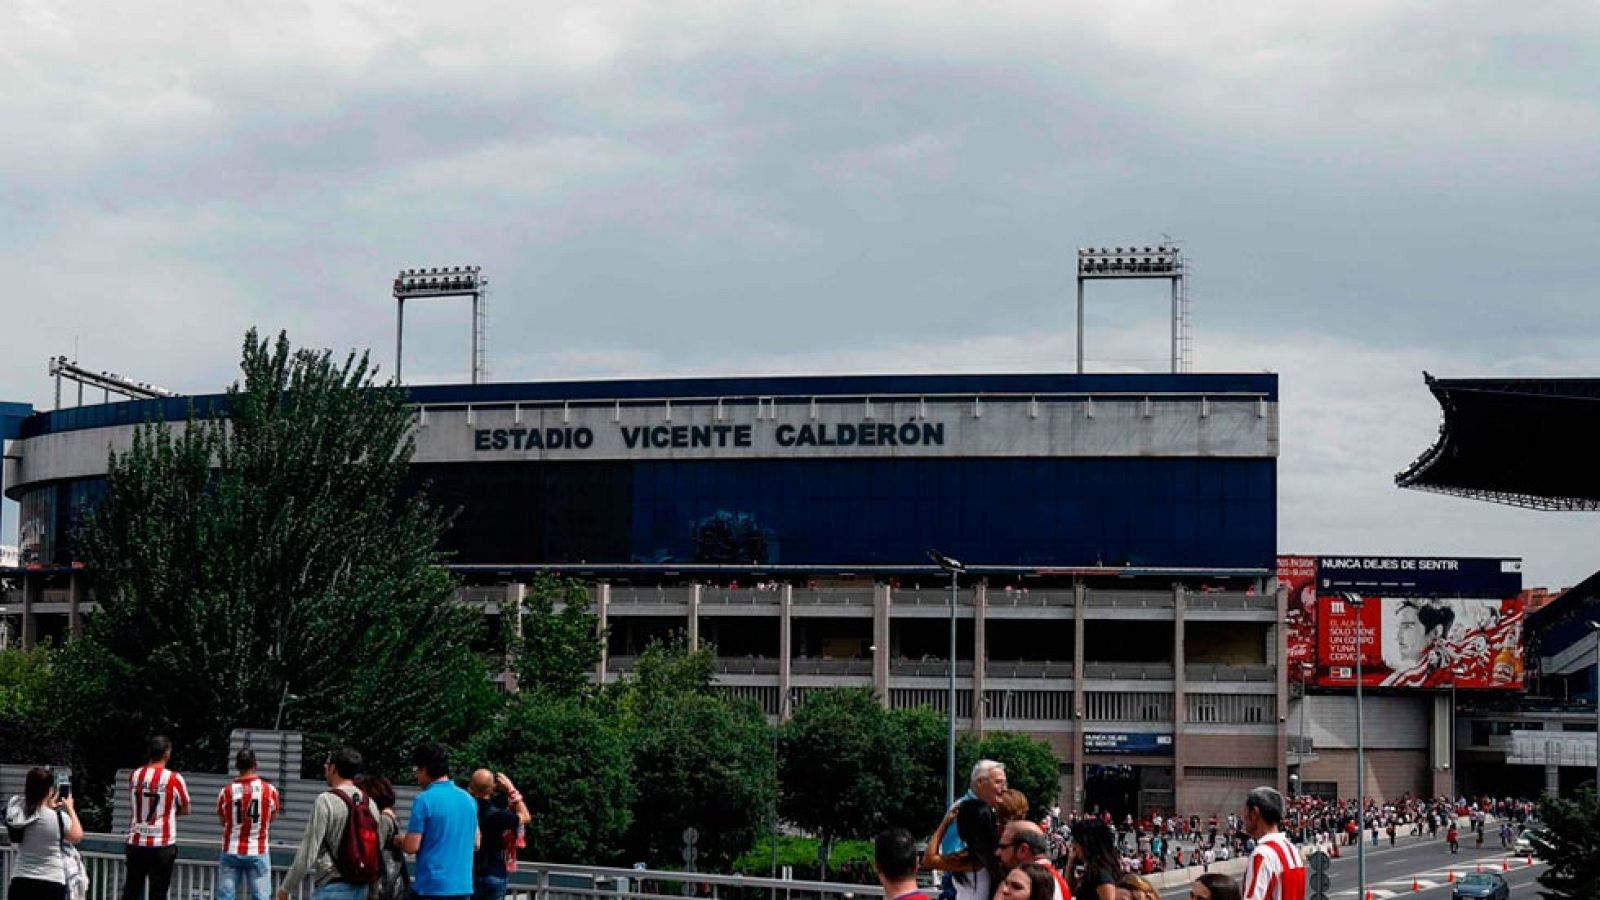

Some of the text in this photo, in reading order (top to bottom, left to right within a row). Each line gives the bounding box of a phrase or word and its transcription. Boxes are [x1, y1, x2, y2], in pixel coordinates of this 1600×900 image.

[474, 416, 945, 451] ESTADIO VICENTE CALDERÓN
[1321, 559, 1459, 570] NUNCA DEJES DE SENTIR
[134, 791, 161, 826] 17
[234, 798, 260, 825] 14
